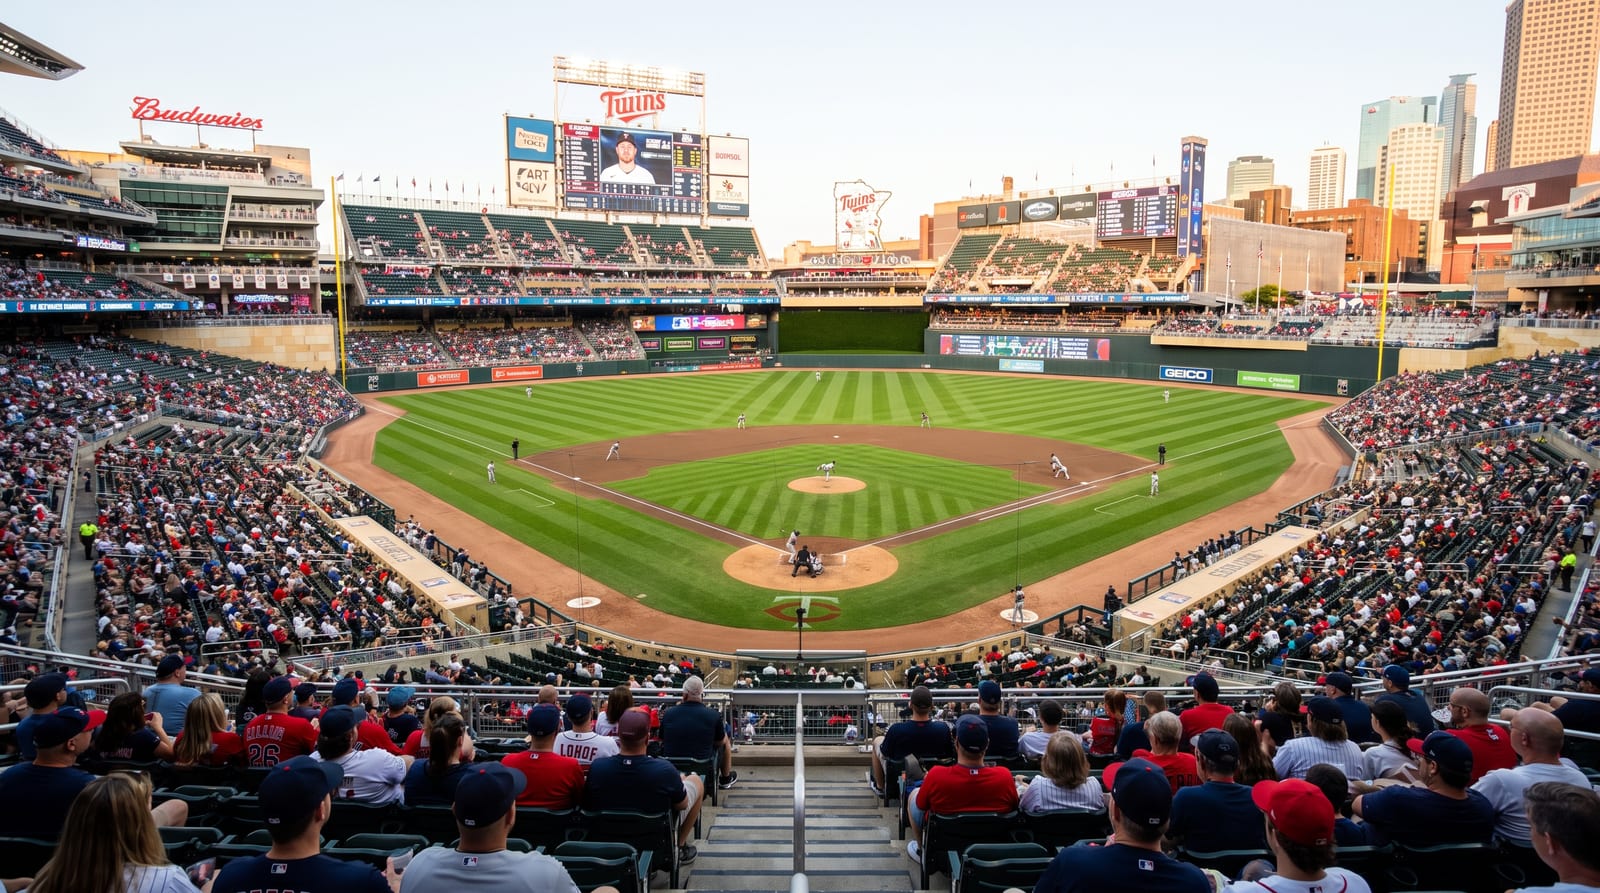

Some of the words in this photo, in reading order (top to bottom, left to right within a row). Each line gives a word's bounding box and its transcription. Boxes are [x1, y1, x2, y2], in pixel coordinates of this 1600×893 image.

[600, 89, 666, 118] Twins
[839, 193, 876, 212] Twins
[1164, 368, 1208, 380] GEICO
[248, 743, 281, 769] 26
